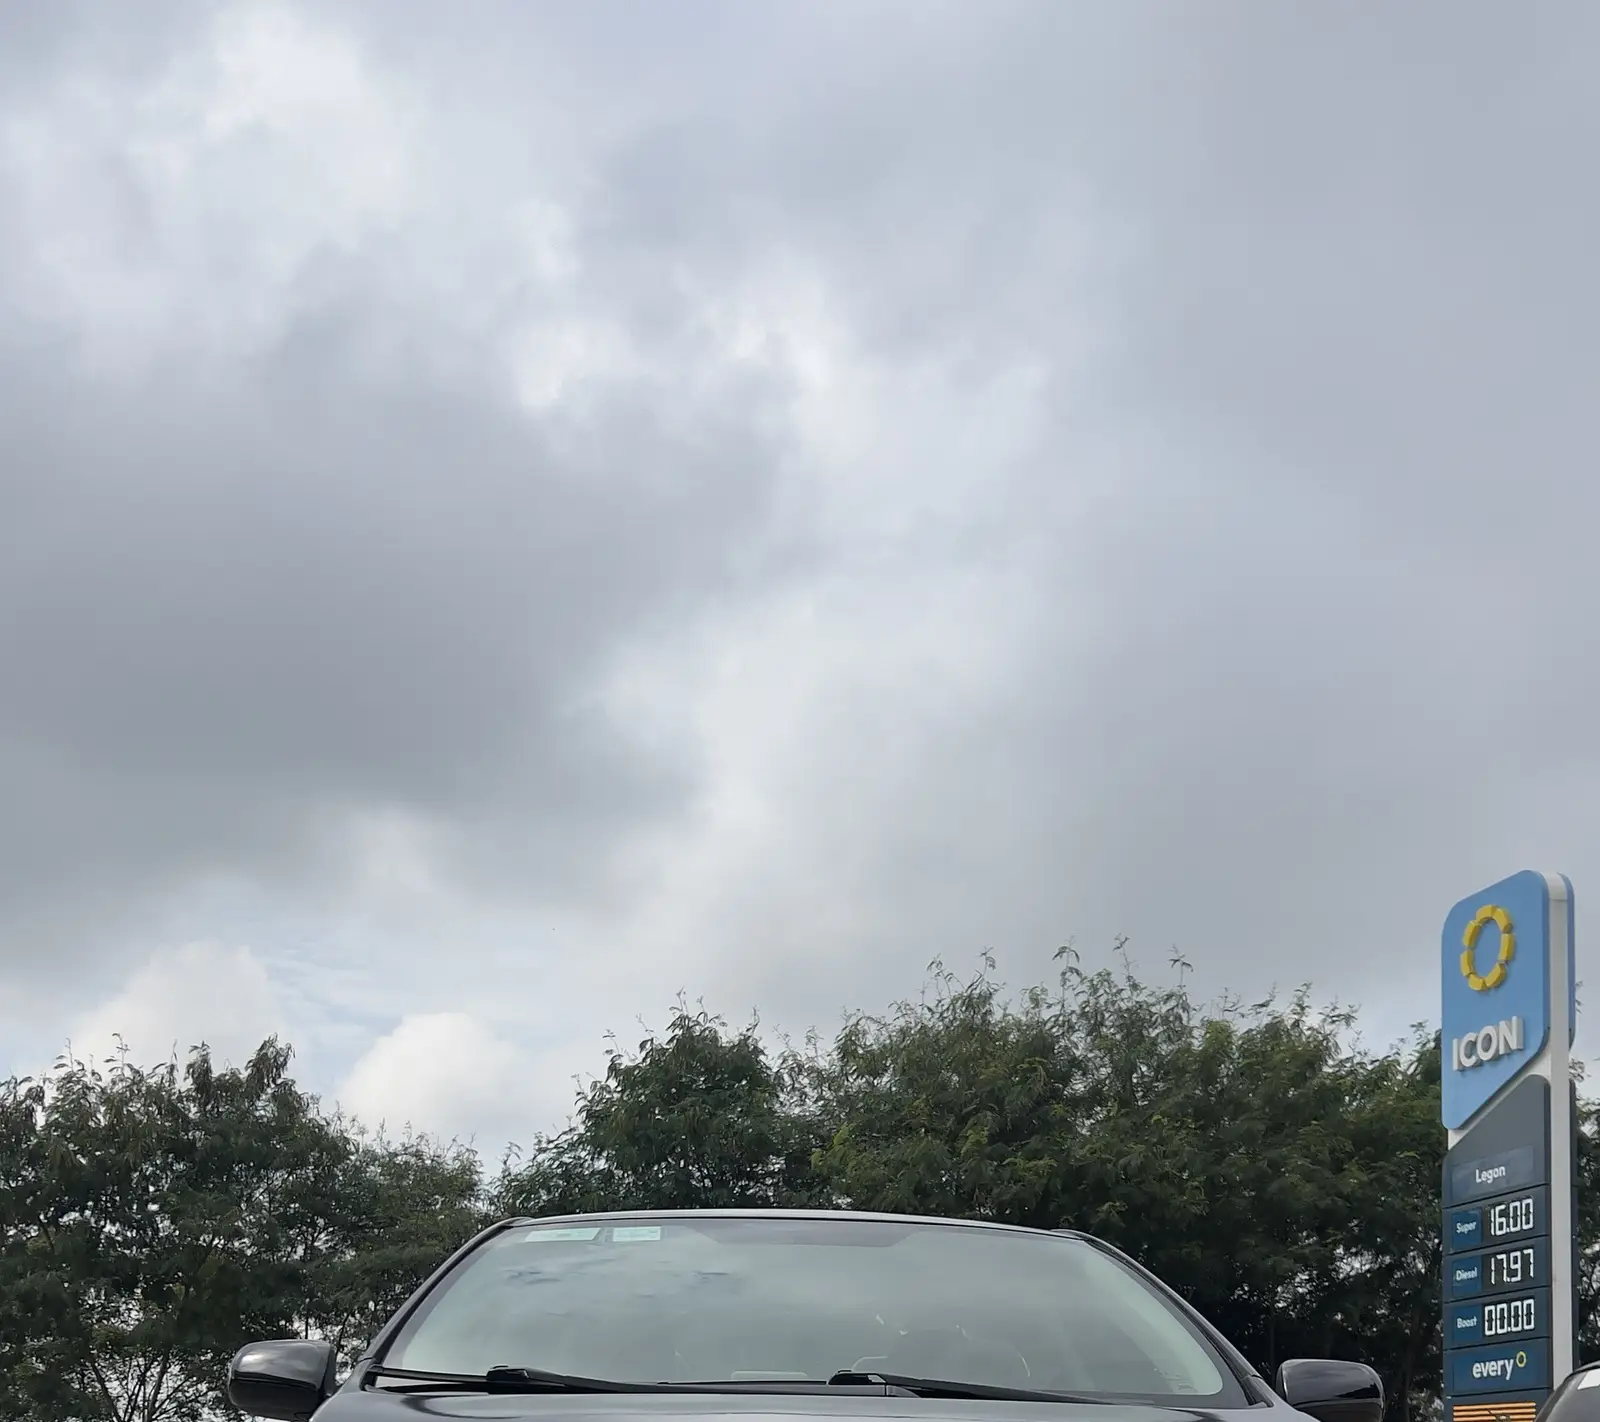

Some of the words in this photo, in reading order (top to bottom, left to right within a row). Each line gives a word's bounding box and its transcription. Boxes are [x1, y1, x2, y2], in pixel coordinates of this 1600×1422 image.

[1453, 1016, 1523, 1071] ICON
[1475, 1165, 1506, 1185] Legon
[1456, 1221, 1477, 1235] Super
[1490, 1199, 1534, 1236] 16.00
[1456, 1266, 1478, 1282] Diesel
[1490, 1248, 1534, 1285] 17.97
[1456, 1315, 1478, 1329] Boost
[1484, 1298, 1535, 1336] 00.00
